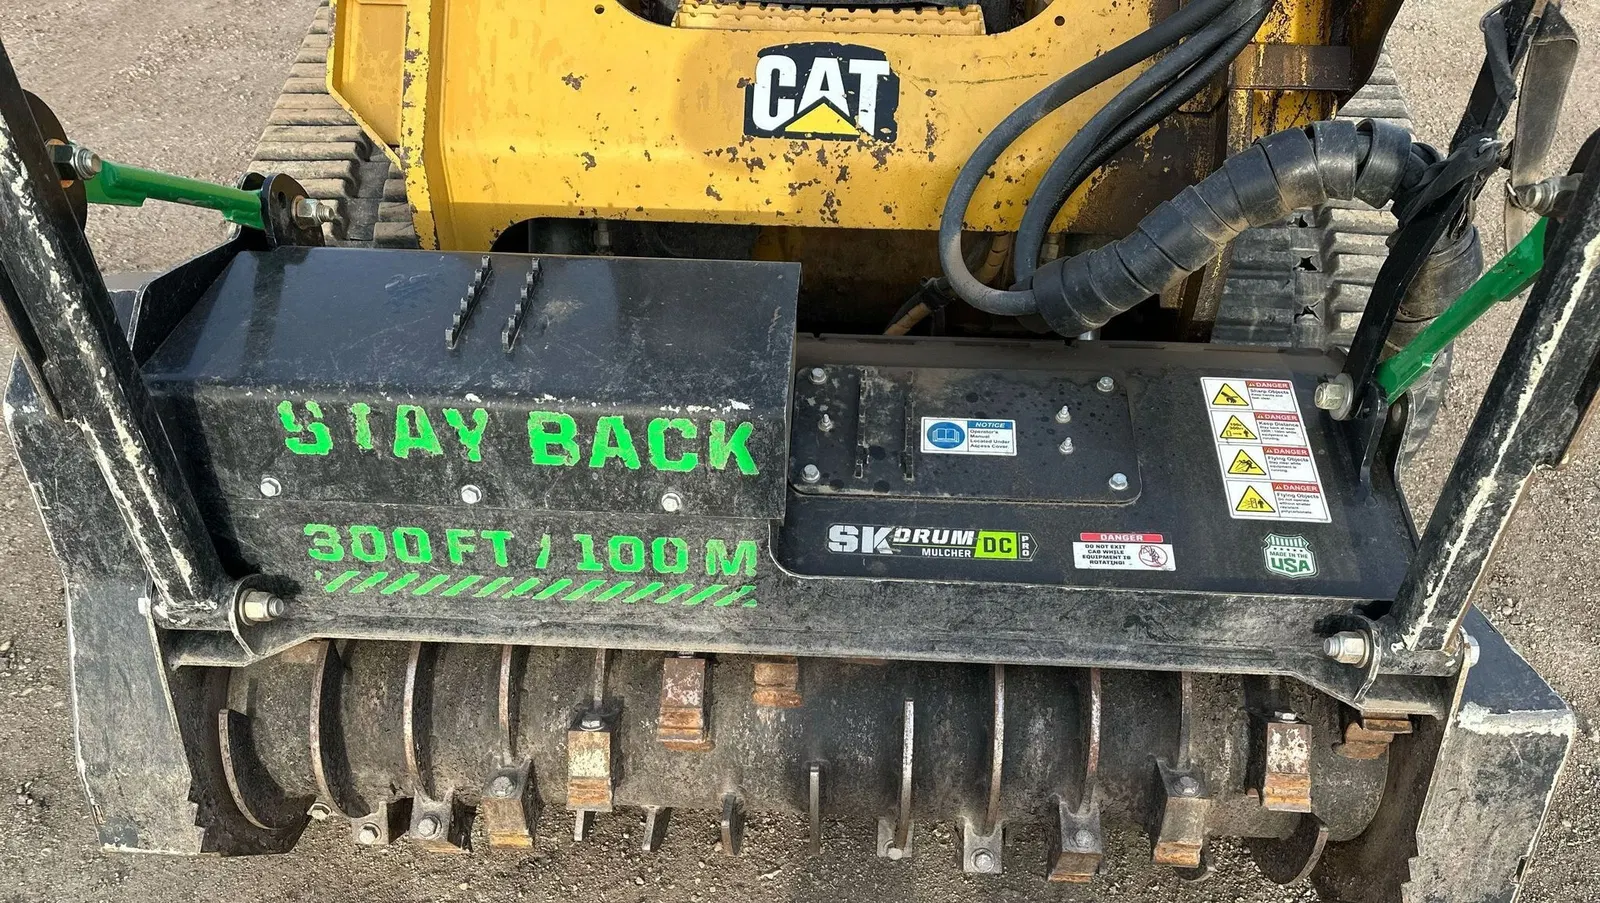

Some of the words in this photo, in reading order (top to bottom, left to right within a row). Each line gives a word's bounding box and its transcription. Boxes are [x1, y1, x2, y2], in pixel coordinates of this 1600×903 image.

[752, 55, 890, 136] CAT
[277, 401, 488, 462] STAY
[528, 410, 758, 475] BACK
[304, 524, 432, 564] 300
[446, 529, 515, 568] FT
[536, 532, 551, 569] /
[572, 533, 689, 574] 100
[705, 539, 758, 577] M
[828, 525, 893, 554] SK
[893, 528, 975, 545] DRUM
[983, 537, 1012, 554] DC
[1022, 536, 1030, 557] PRO
[922, 548, 971, 558] MULCHER
[1271, 558, 1310, 573] USA
